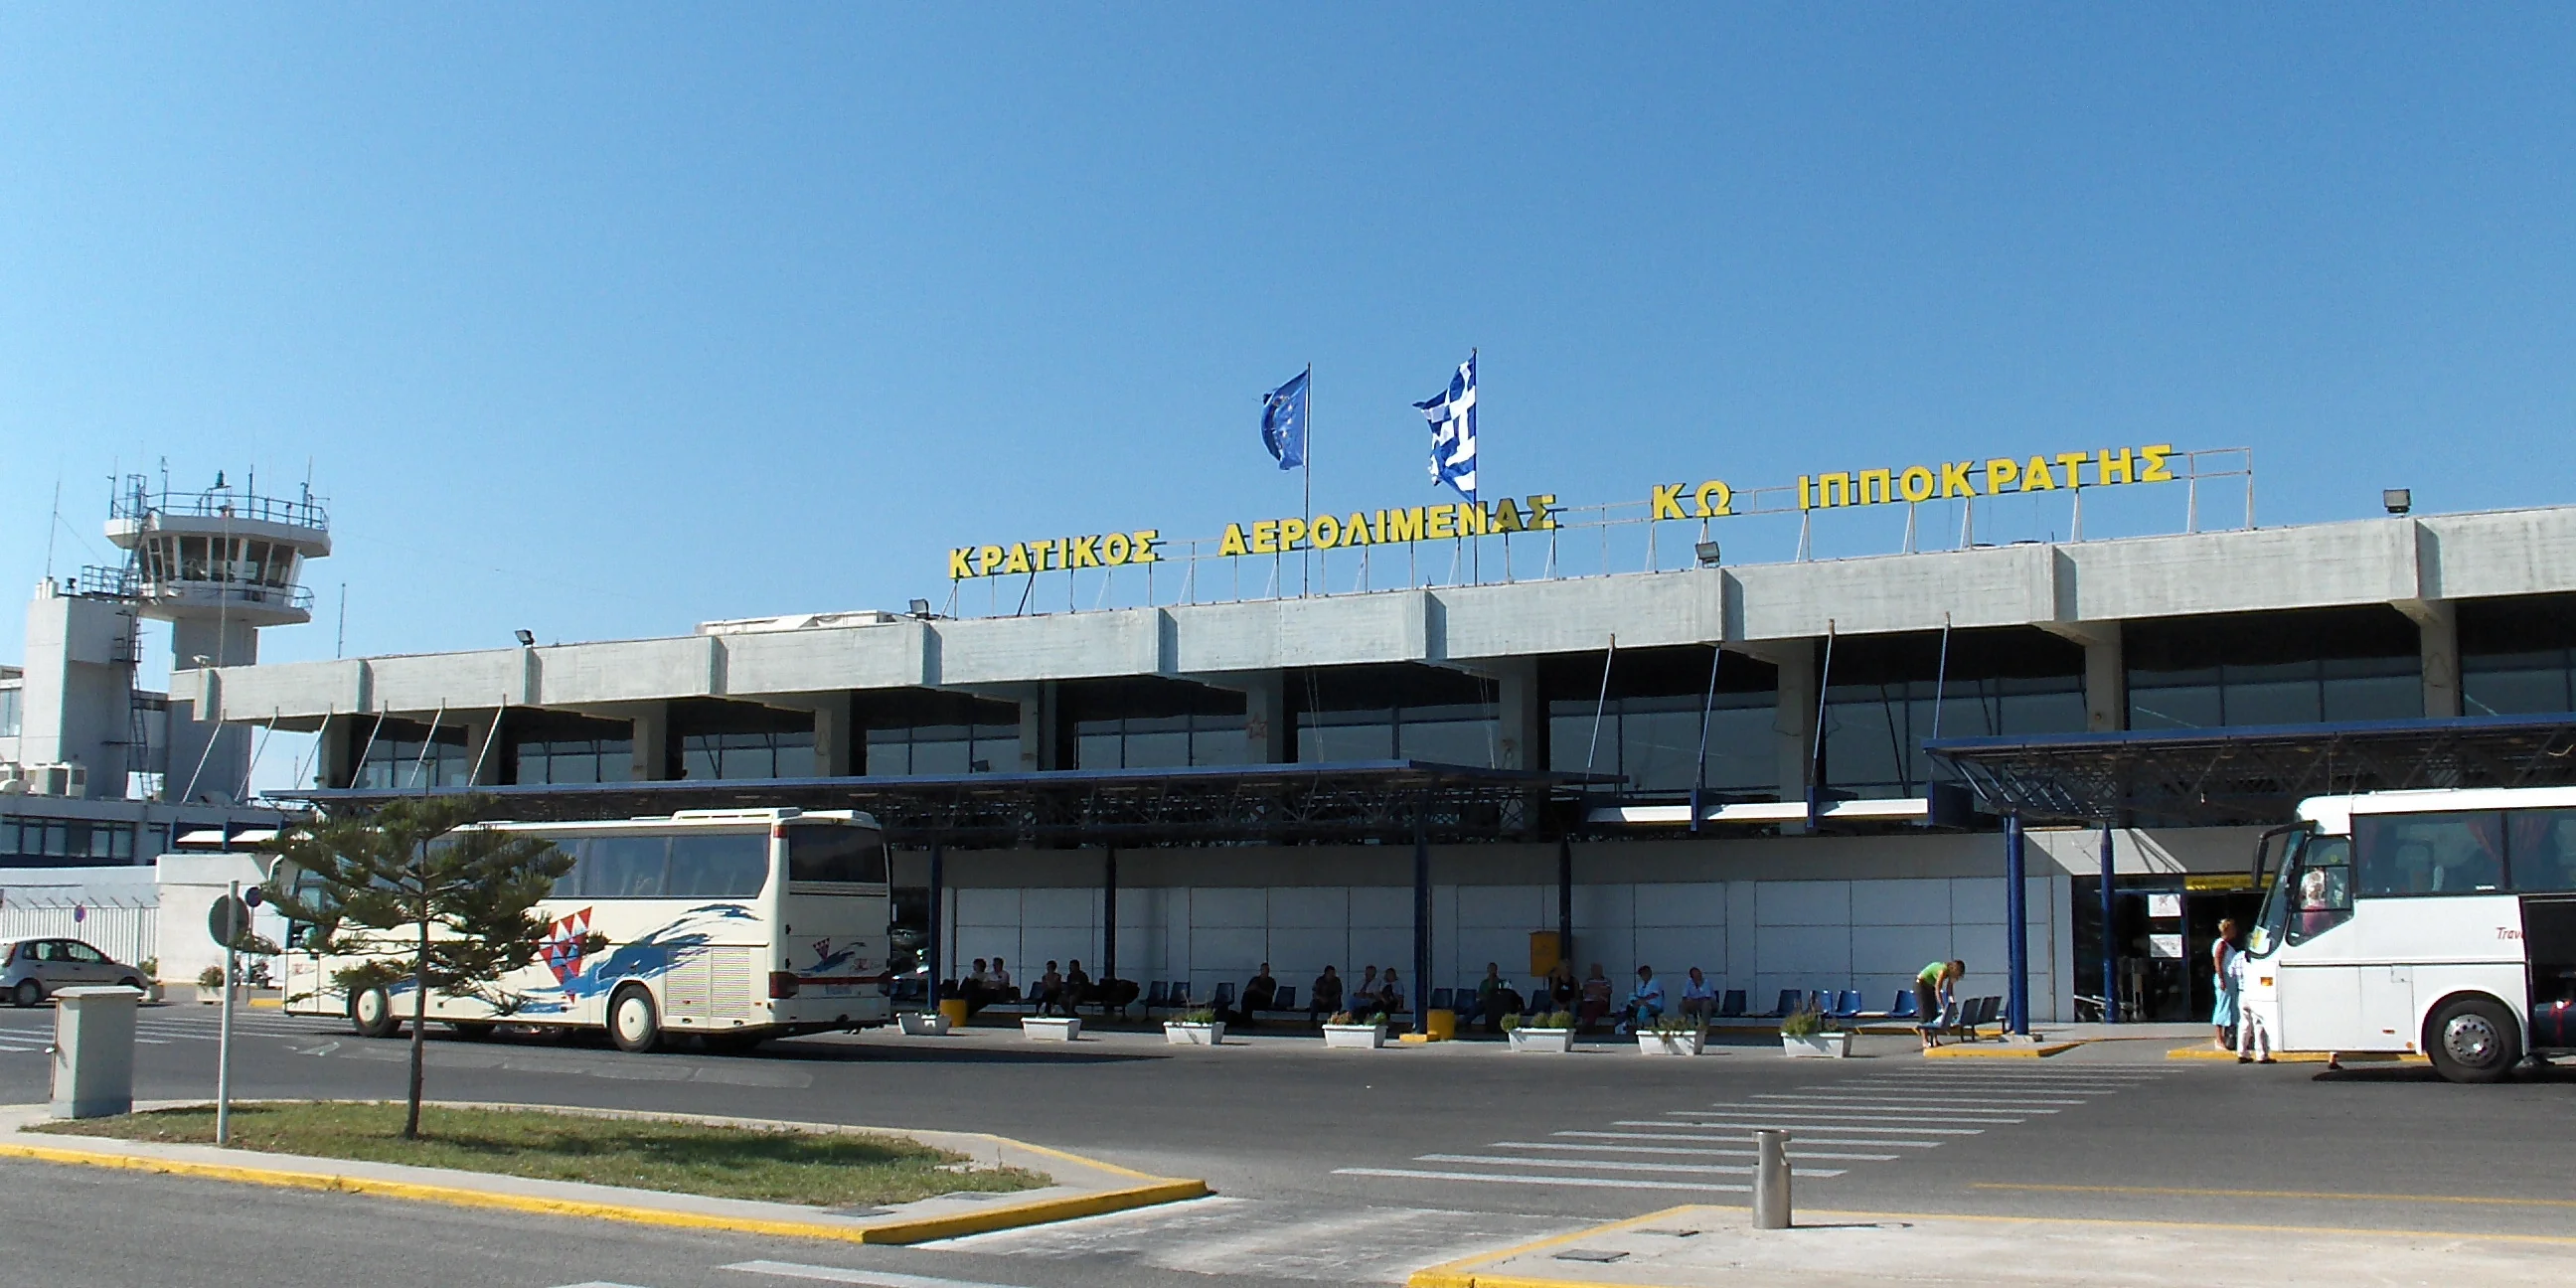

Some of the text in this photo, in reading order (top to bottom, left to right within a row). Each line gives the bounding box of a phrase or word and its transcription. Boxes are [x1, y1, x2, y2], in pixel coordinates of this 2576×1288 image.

[951, 443, 2174, 579] ΚΡΑΤΙΚΟΣ ΑΕΡΟΛΙΜΕΝΑΣ ΚΩ ΙΠΠΟΚΡΑΤΗΣ
